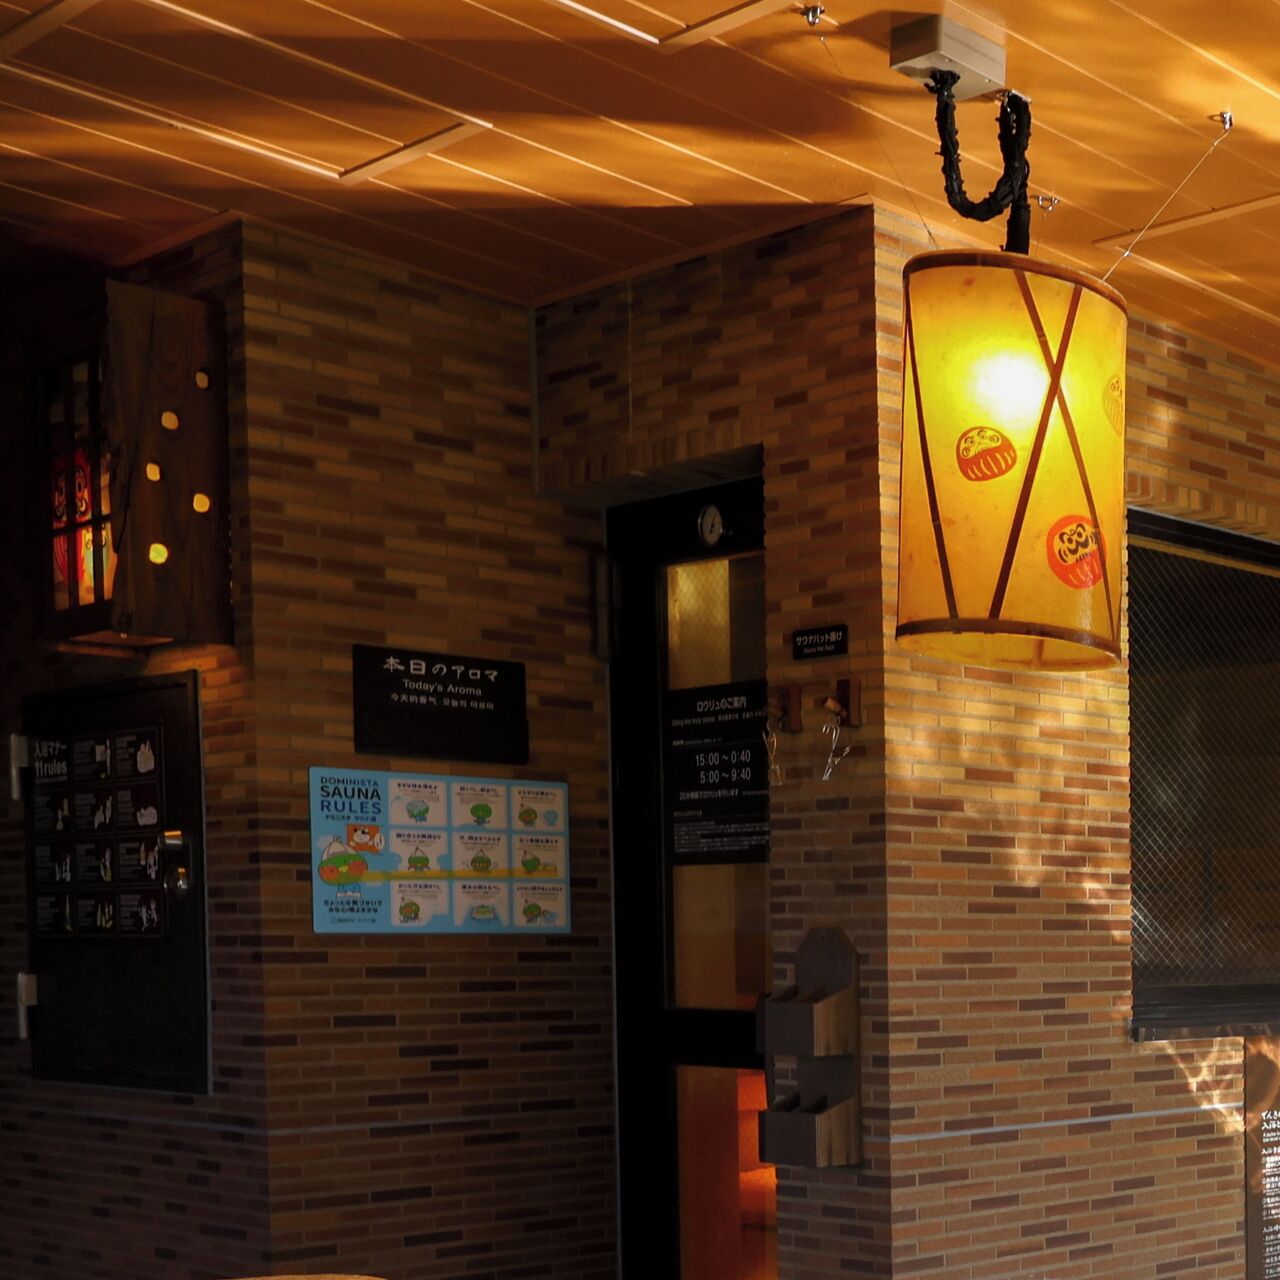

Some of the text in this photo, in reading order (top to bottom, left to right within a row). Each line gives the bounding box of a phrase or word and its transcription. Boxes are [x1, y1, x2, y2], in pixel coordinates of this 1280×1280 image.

[382, 655, 499, 683] 本日のアロマ
[402, 678, 483, 697] Today's Aroma
[695, 751, 720, 768] 15:00
[731, 749, 751, 764] 0:40
[700, 769, 720, 785] 5:00
[731, 767, 751, 782] 9:40
[320, 785, 381, 801] SAUNA
[320, 800, 382, 815] RULES
